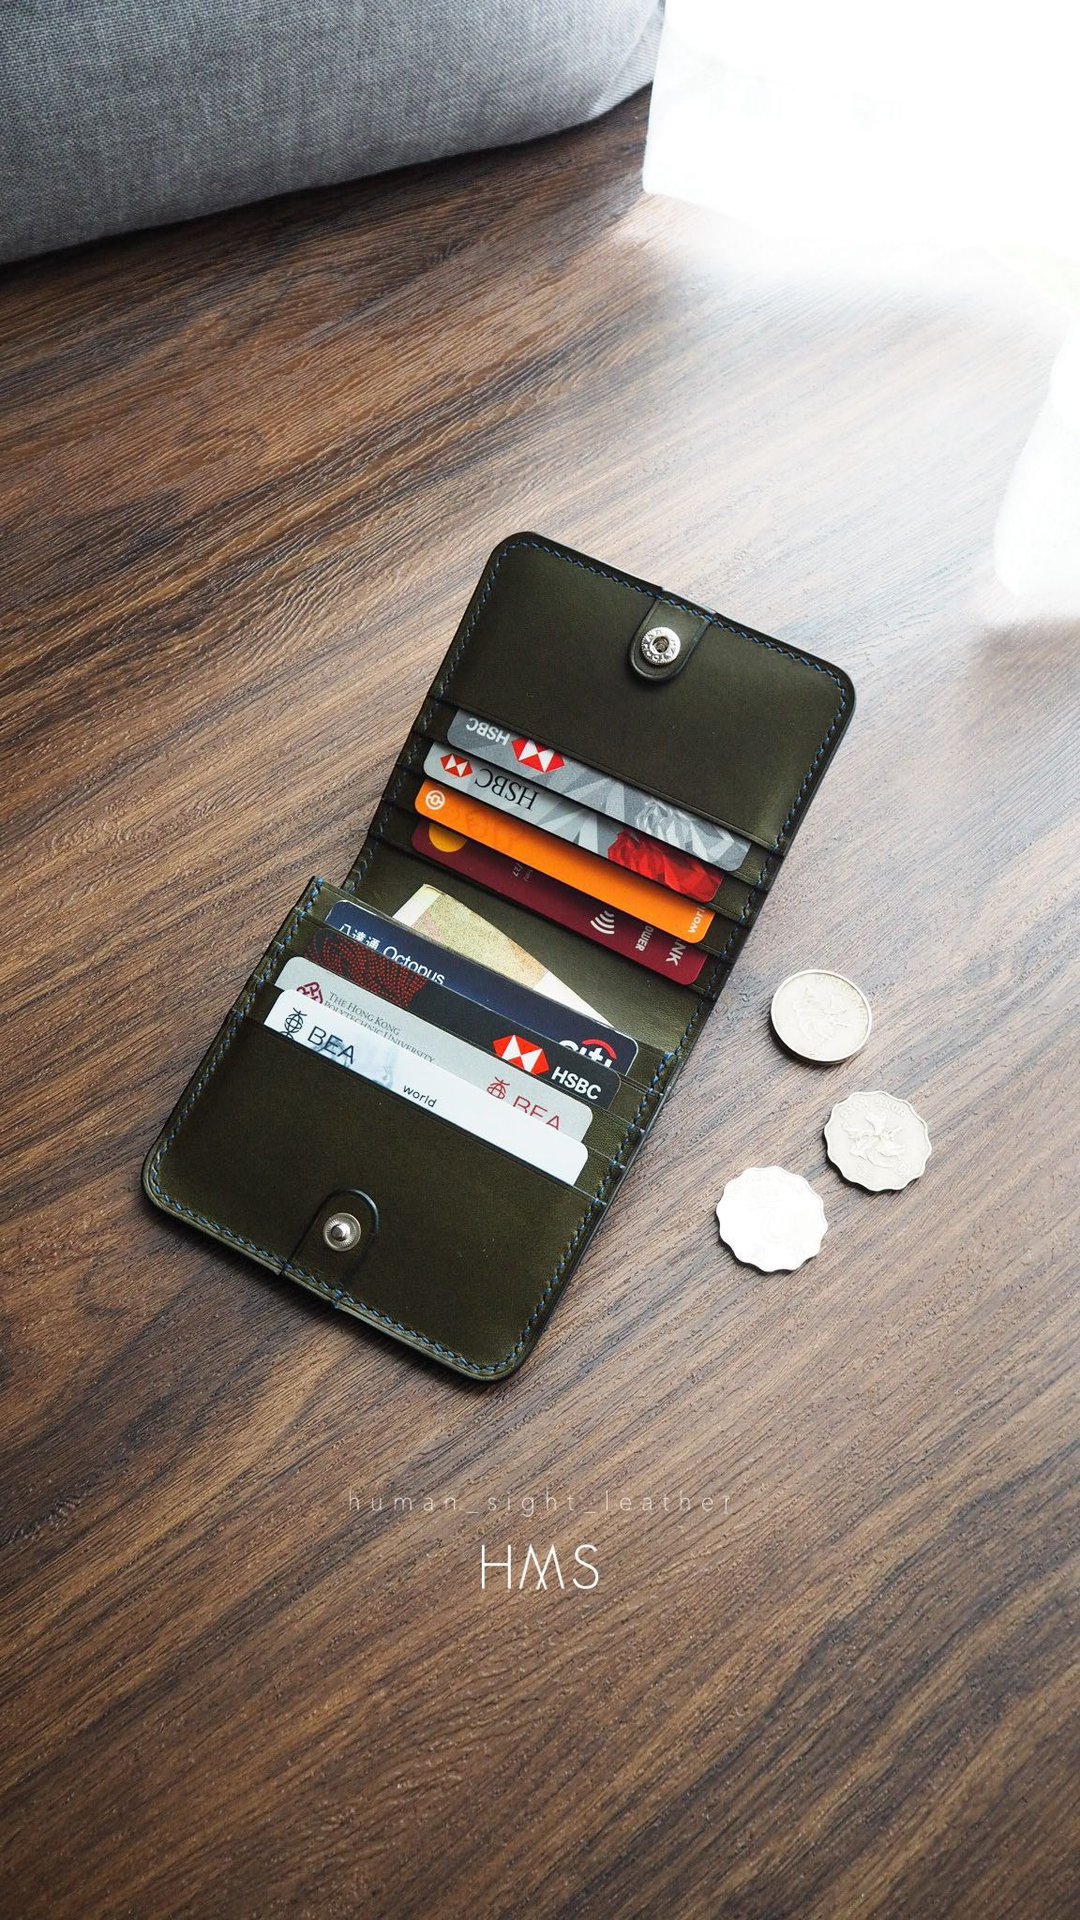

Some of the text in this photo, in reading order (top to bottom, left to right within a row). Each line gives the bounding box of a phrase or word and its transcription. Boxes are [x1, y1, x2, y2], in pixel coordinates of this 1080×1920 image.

[466, 717, 510, 746] HSBC
[474, 768, 538, 810] HSBC
[687, 906, 706, 934] worl
[635, 925, 654, 951] OWER
[665, 940, 687, 967] NK
[383, 945, 445, 985] Octopus
[329, 991, 402, 1037] THE HONG KONG
[307, 1025, 355, 1065] BEA
[402, 1084, 438, 1108] world
[551, 1066, 602, 1100] HSBC
